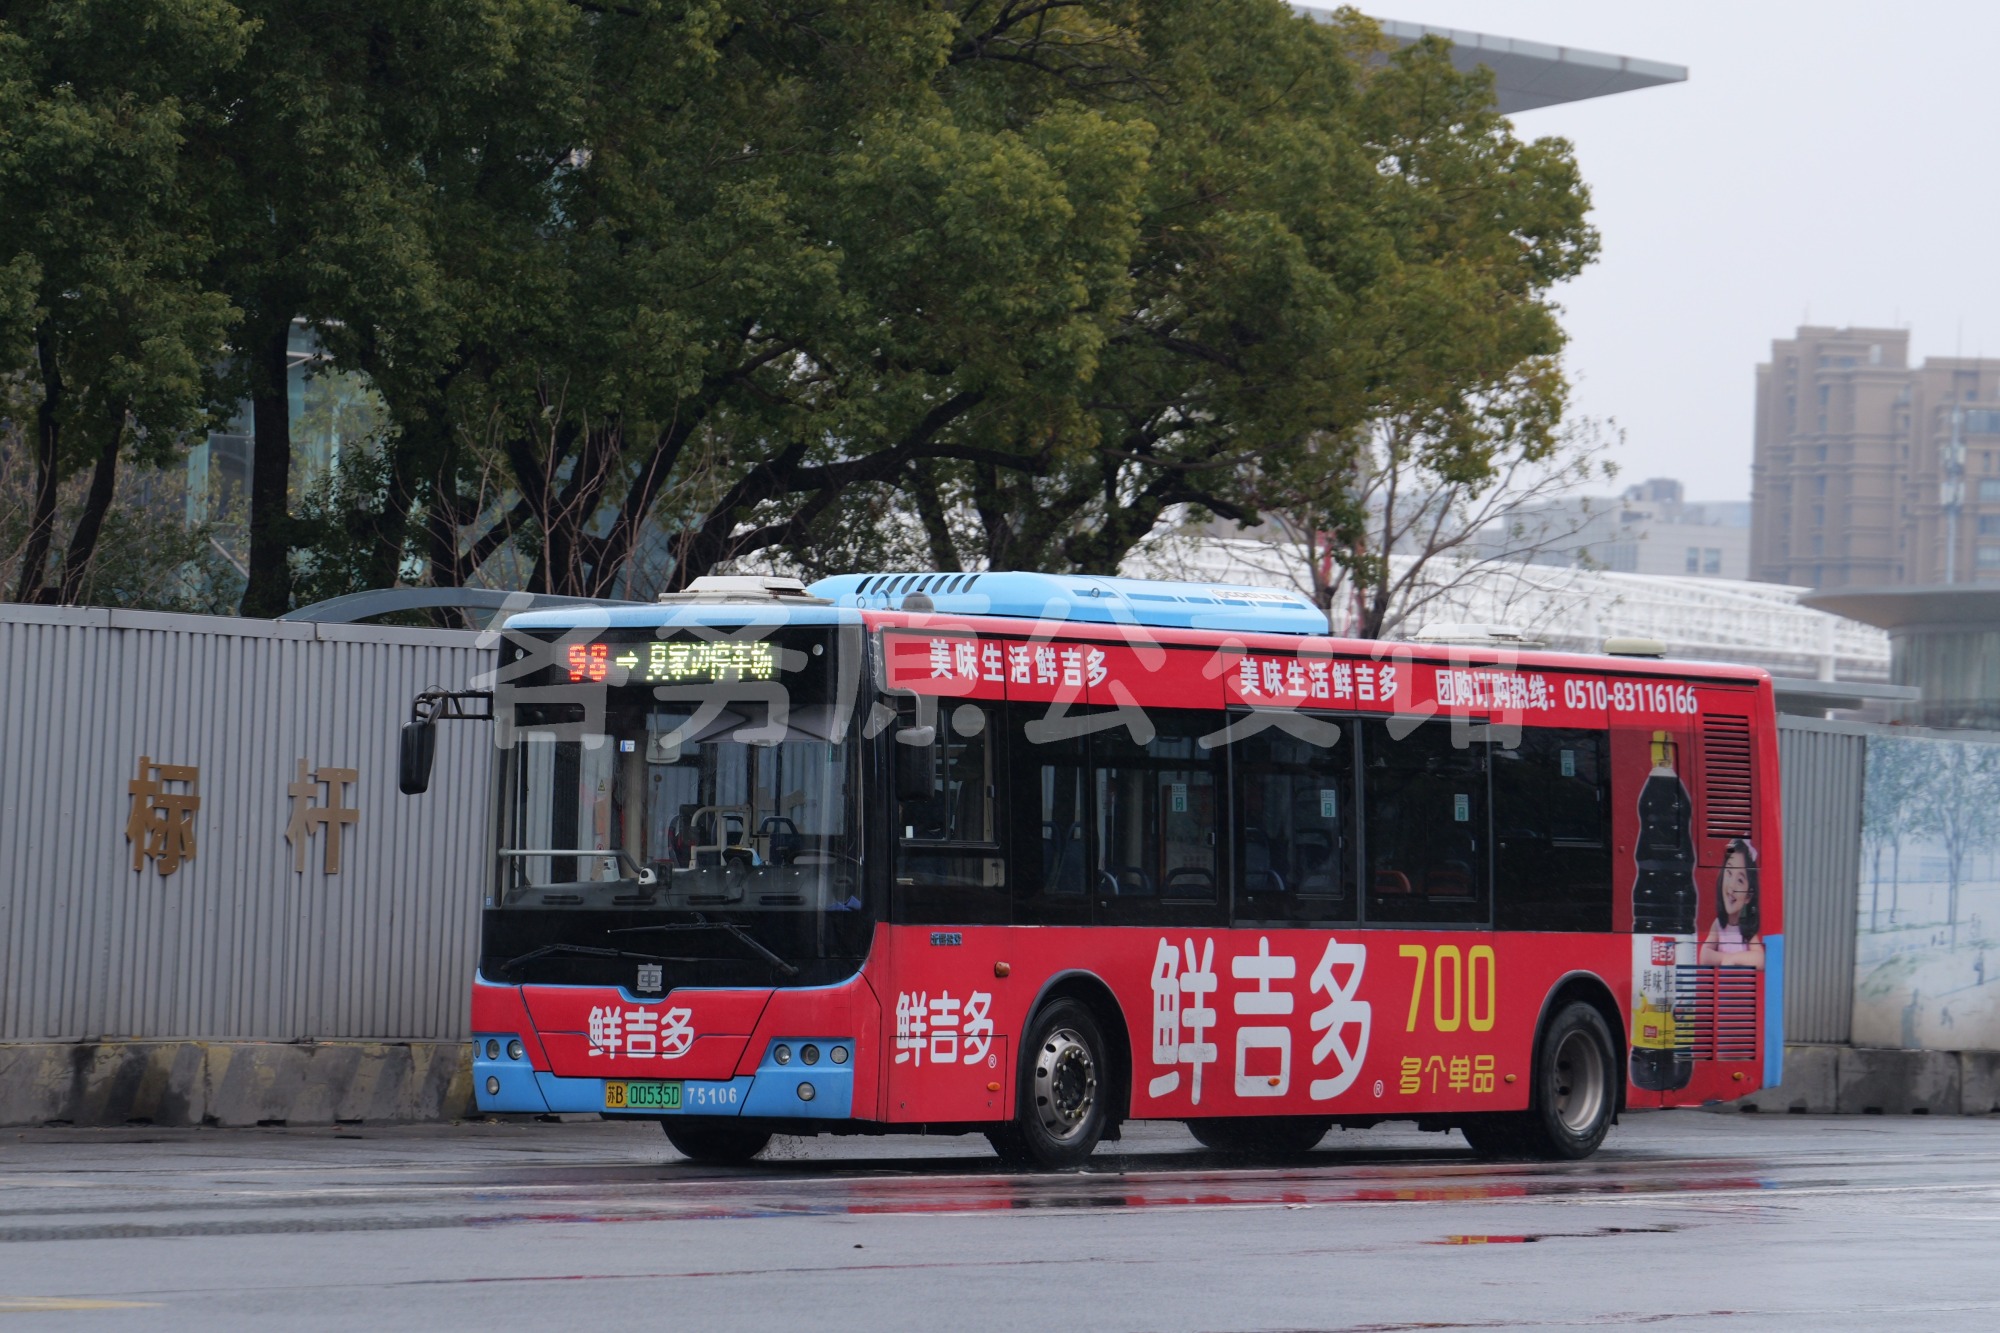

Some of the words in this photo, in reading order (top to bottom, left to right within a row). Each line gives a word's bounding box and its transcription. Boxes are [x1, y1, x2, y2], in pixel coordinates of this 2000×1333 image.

[569, 643, 607, 681] 98
[930, 638, 1108, 687] 美味生活鲜吉多
[1240, 657, 1398, 702] 美味生活鲜吉多
[1565, 679, 1697, 714] 0510-83116166
[1399, 944, 1495, 1032] 700
[588, 1005, 694, 1060] 鲜吉多
[895, 990, 994, 1067] 鲜吉多
[1149, 936, 1372, 1104] 鲜吉多
[687, 1087, 737, 1105] 75106
[1400, 1055, 1495, 1094] 多个单品
